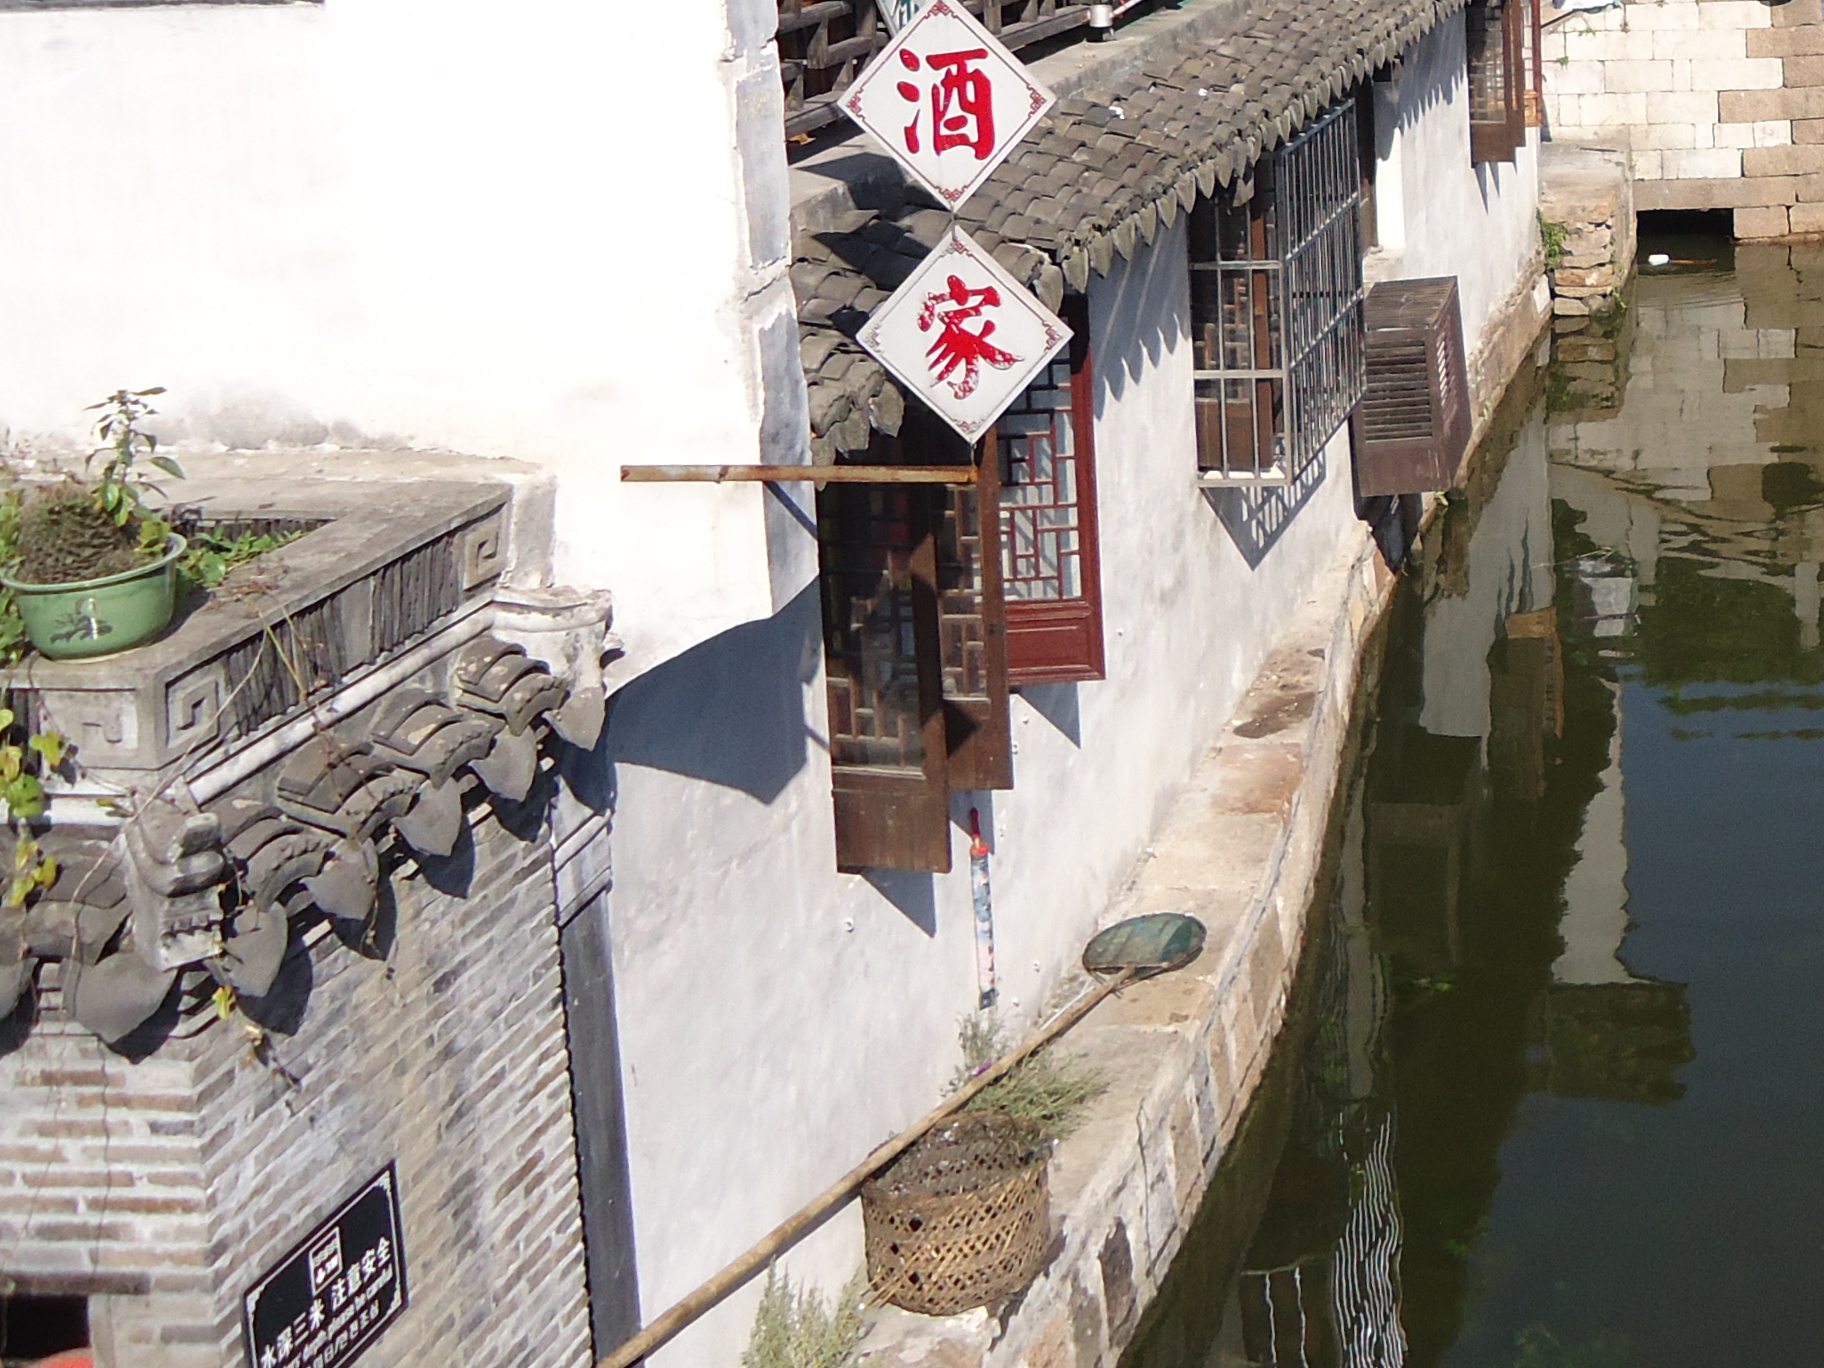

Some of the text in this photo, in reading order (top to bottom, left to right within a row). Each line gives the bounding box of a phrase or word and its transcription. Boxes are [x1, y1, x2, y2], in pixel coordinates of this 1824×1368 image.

[897, 47, 994, 160] 酒
[918, 274, 1024, 399] 家
[331, 1237, 391, 1312] 注意安全
